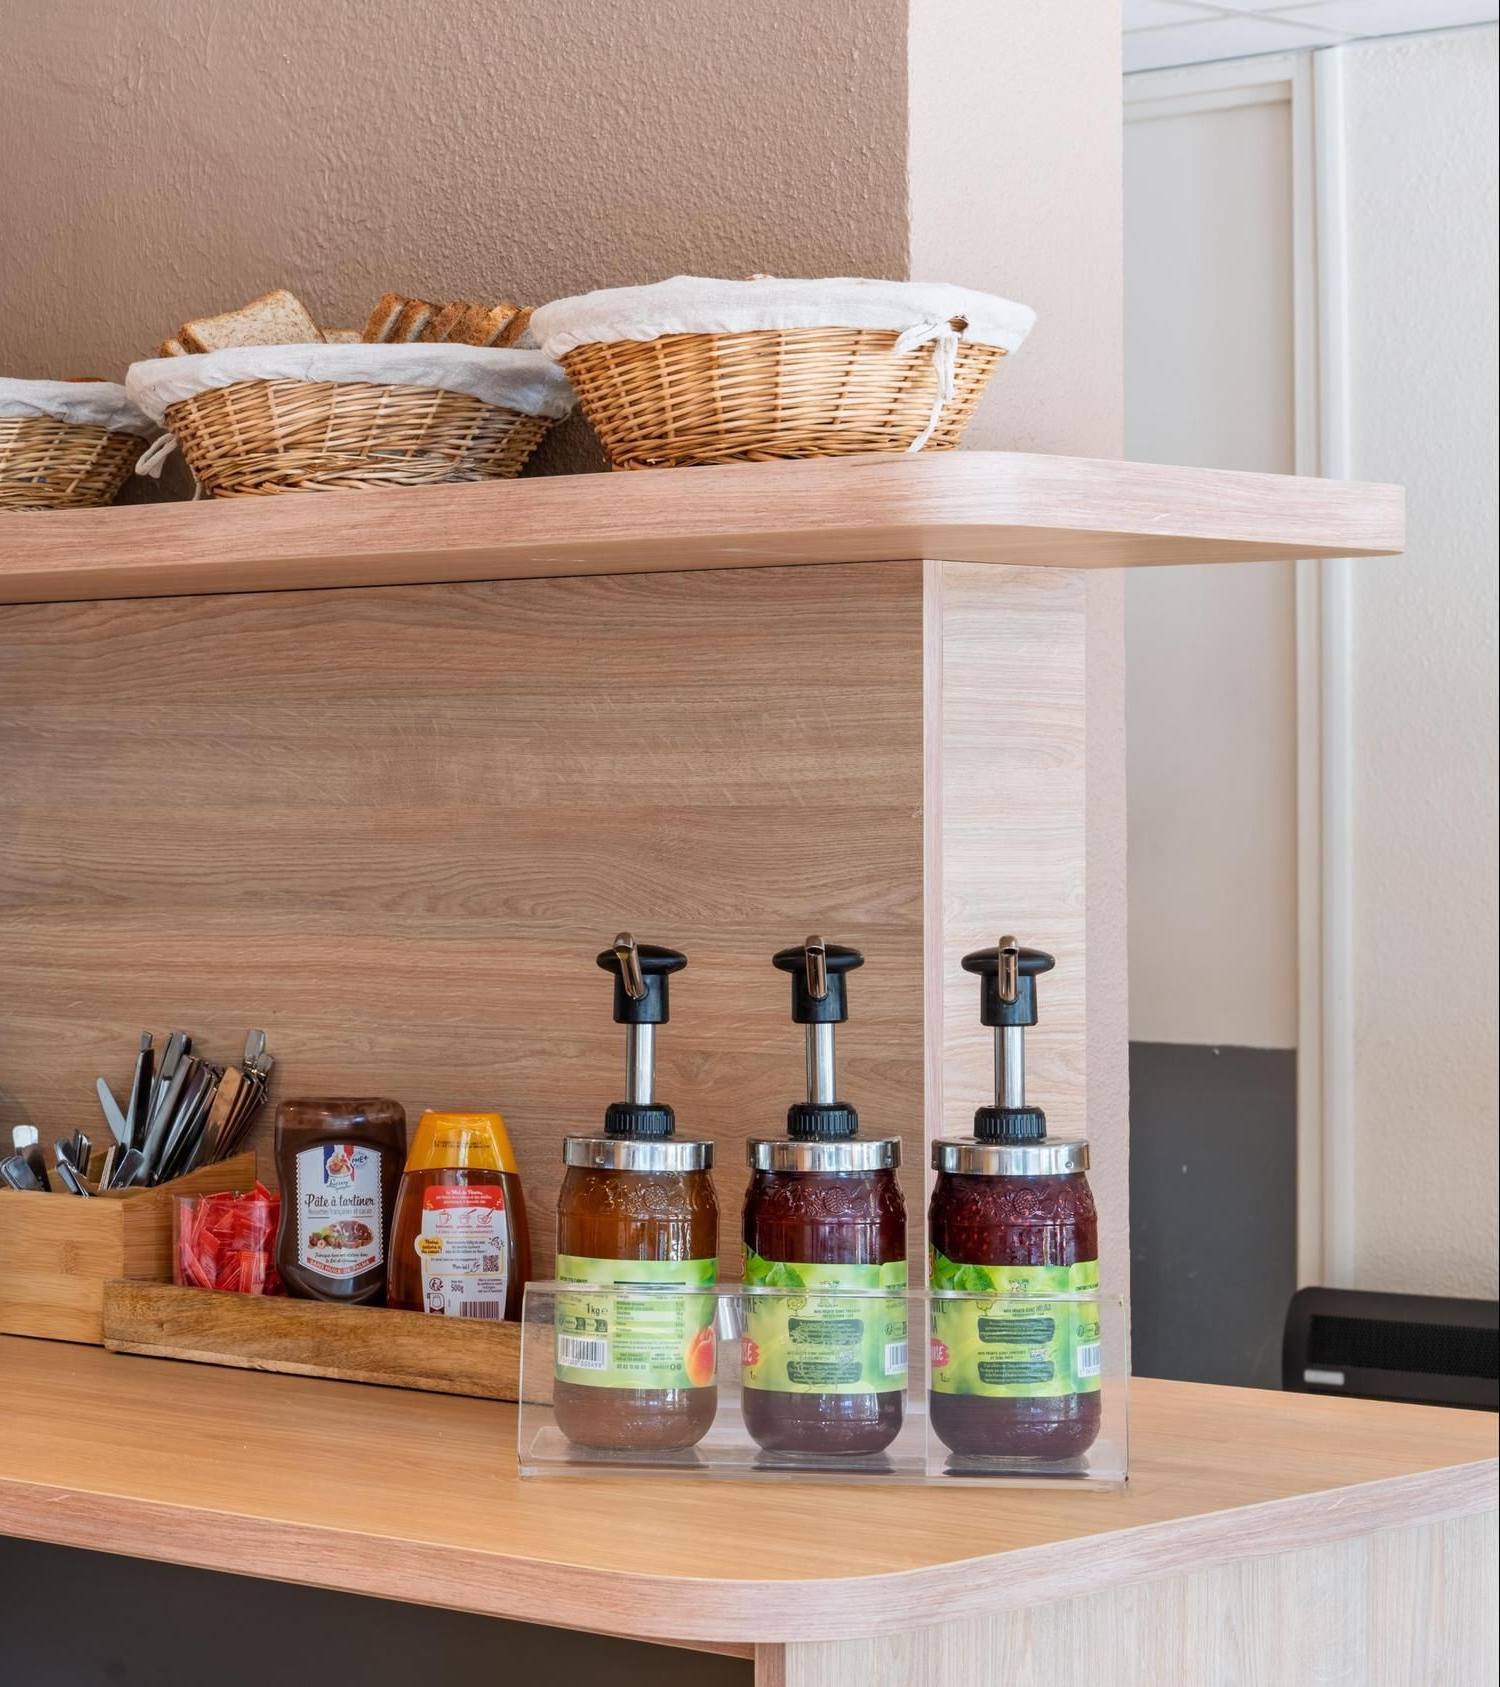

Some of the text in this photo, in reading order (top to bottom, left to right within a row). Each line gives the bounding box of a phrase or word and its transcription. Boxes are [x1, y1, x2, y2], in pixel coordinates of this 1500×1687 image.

[304, 1193, 376, 1208] Pâte à tartiner
[451, 1284, 464, 1294] 500g
